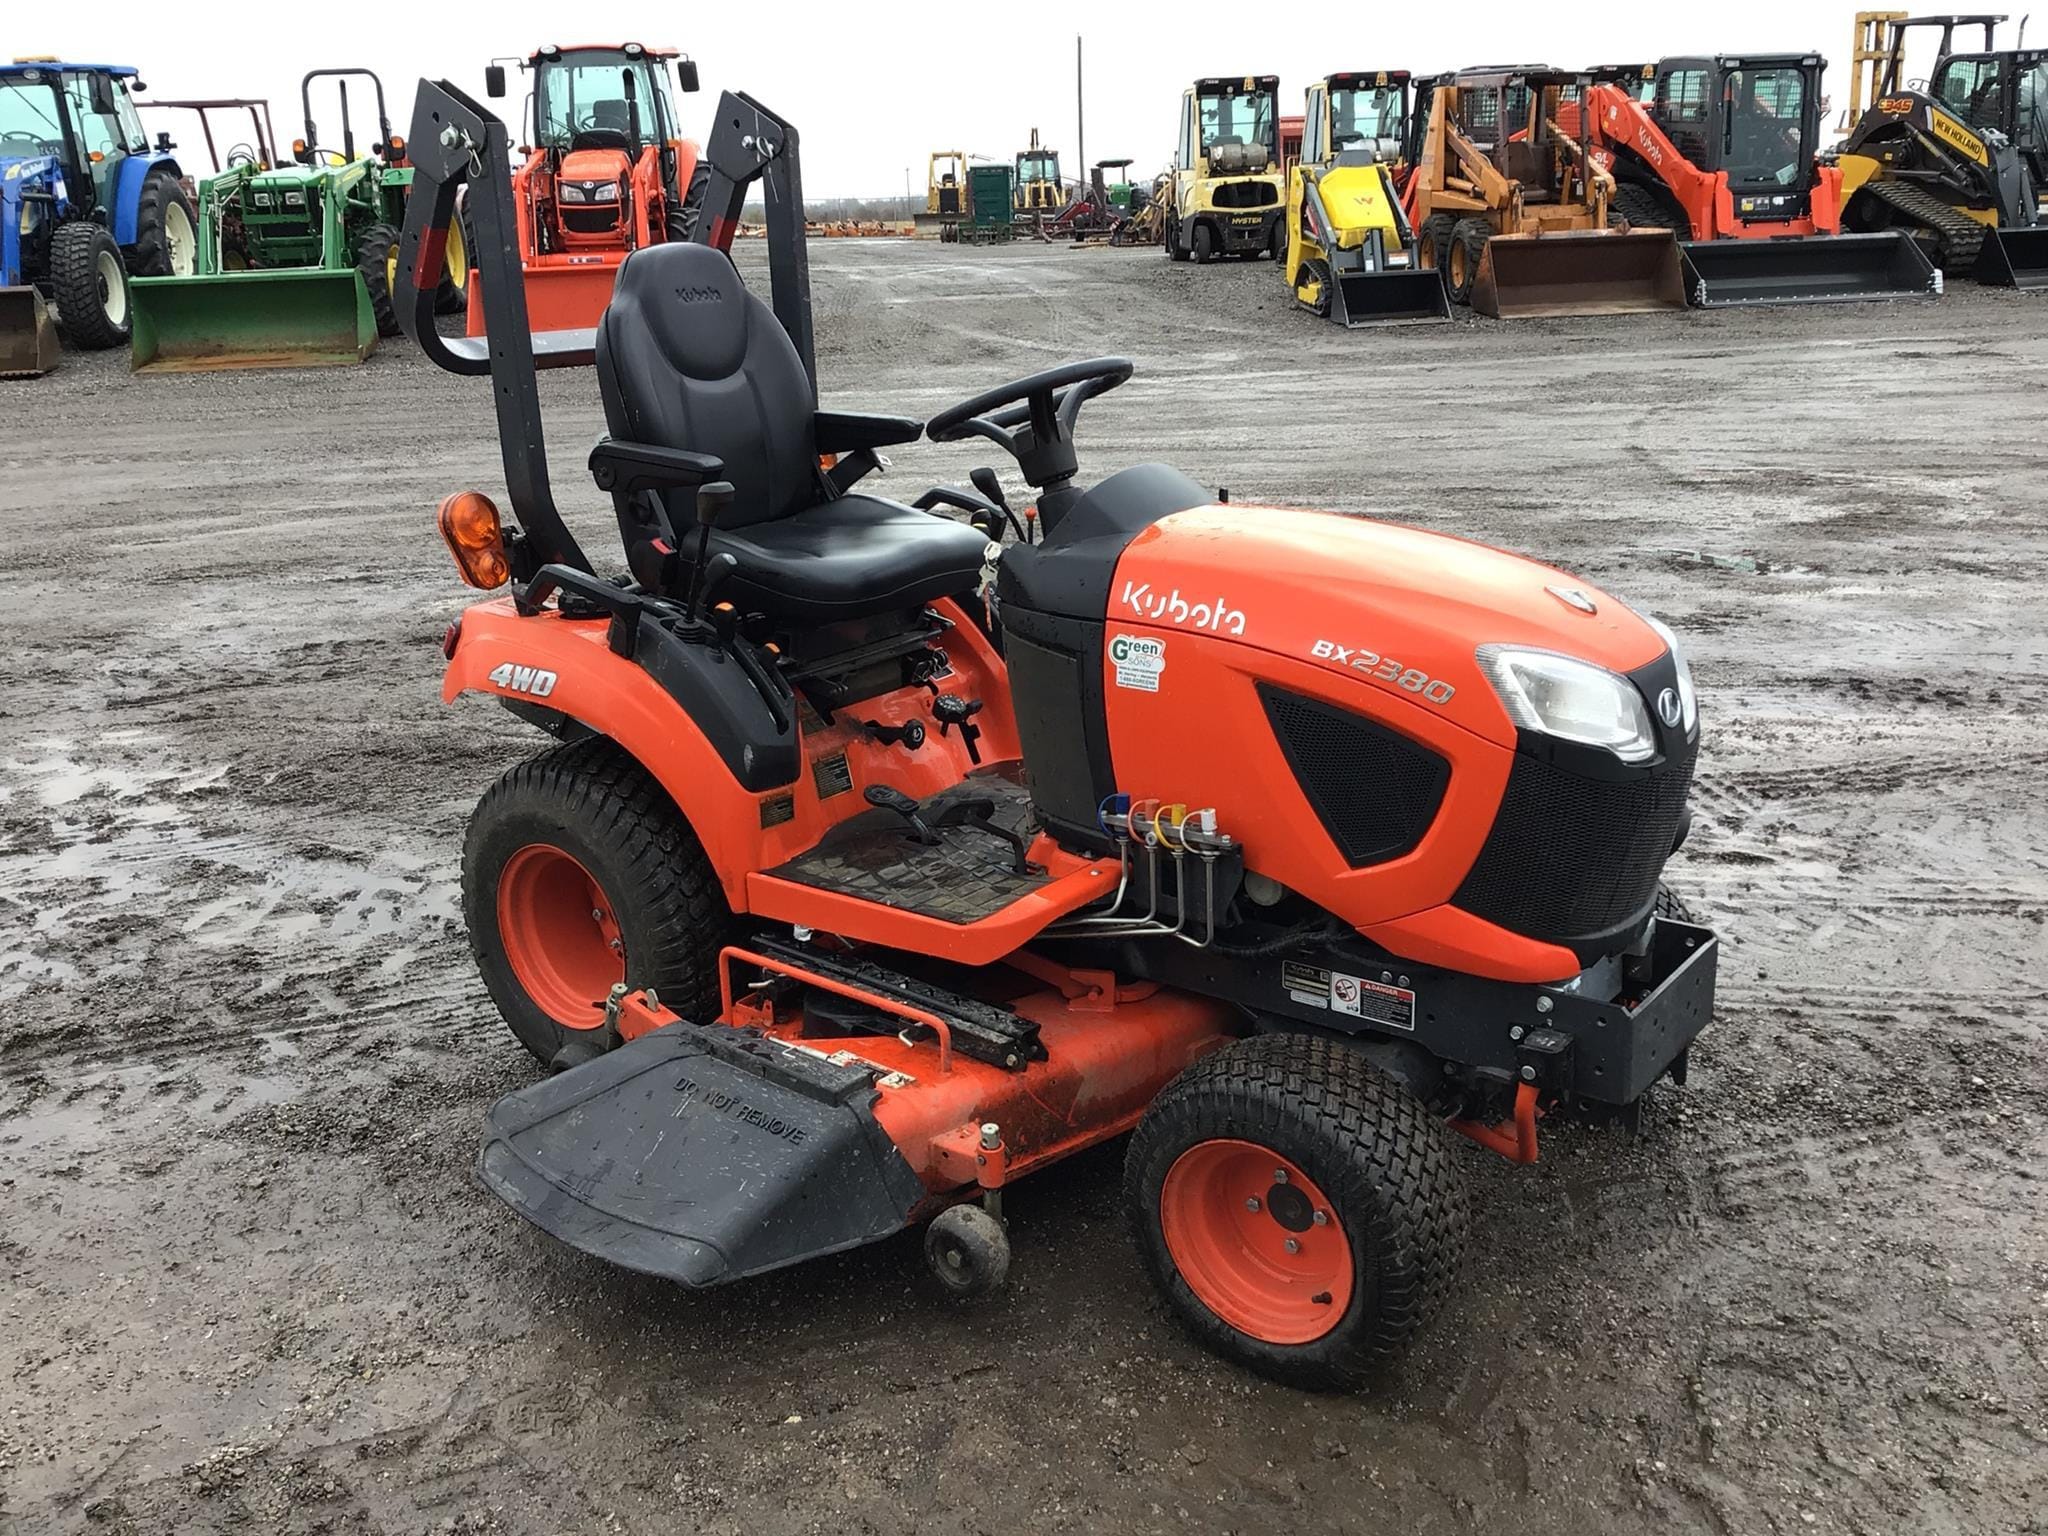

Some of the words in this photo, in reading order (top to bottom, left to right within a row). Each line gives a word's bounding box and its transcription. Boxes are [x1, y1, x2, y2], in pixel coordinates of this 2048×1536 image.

[1638, 125, 1663, 167] Kubota
[1936, 118, 1951, 136] NEW
[1951, 128, 1982, 155] HOLLAND
[1231, 216, 1263, 225] HYSTER
[674, 285, 723, 303] Kubota
[1121, 580, 1247, 636] Kubota
[1112, 638, 1158, 661] Green
[488, 661, 558, 697] 4WD
[1310, 639, 1456, 705] BX2380
[1371, 984, 1399, 997] DANGER
[672, 1077, 699, 1096] DO
[702, 1091, 741, 1114] NOT
[736, 1104, 807, 1146] REMOVE
